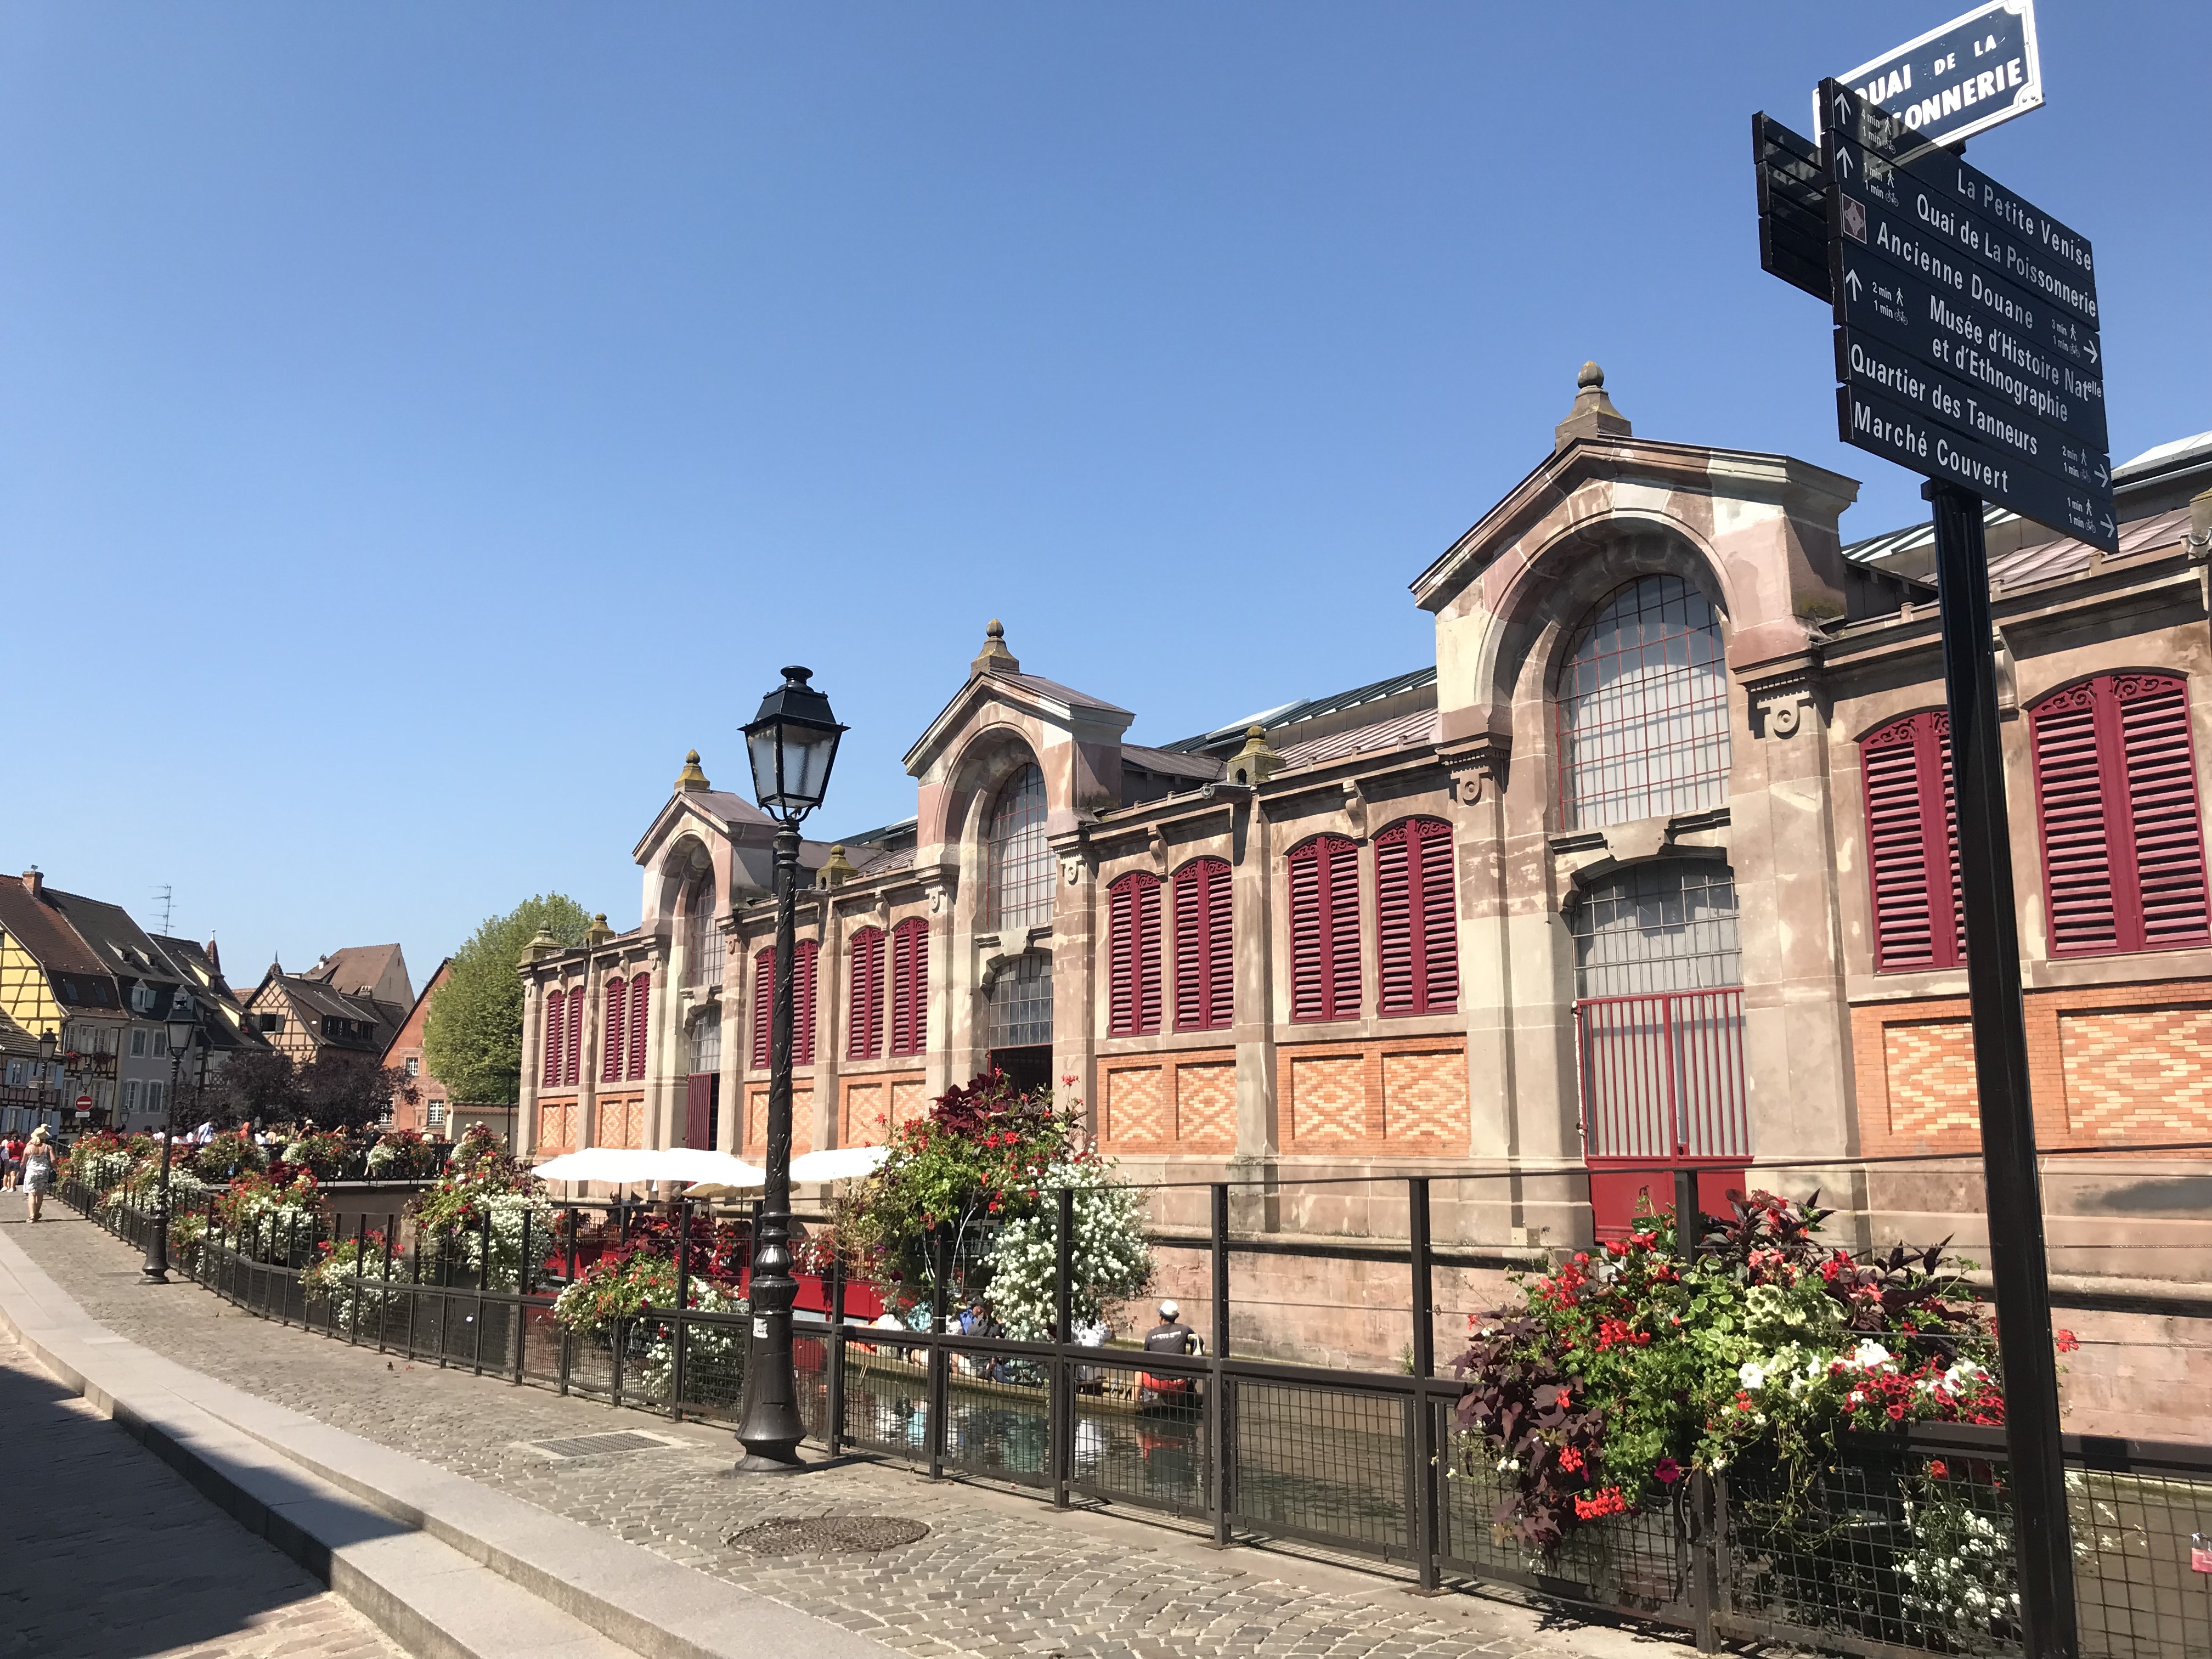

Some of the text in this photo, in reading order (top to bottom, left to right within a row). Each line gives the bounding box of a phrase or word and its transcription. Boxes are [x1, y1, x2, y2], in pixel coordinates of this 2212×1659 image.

[1934, 52, 1956, 76] DE
[1974, 34, 1997, 57] LA
[1892, 57, 2022, 130] ONNERIE
[1861, 108, 1881, 129] 4 min
[1862, 126, 1882, 146] 1 min
[1863, 162, 1883, 182] 1 min
[1864, 179, 1884, 199] 1 min
[1957, 168, 2091, 270] La Petite Venise
[1917, 194, 2096, 317] Quai de La Poissonnerie
[1877, 222, 2033, 329] Ancienne Douane
[1872, 281, 1892, 301] 2 min
[1874, 300, 1893, 319] 1 min
[2051, 319, 2067, 336] 3 min
[1930, 295, 1982, 345] Musée
[1988, 329, 2059, 385] d'Histoire
[2053, 335, 2068, 352] 1 min
[1933, 337, 2068, 422] et d'Ethnographie
[1851, 344, 2038, 455] Quartier des Tanneurs
[1854, 401, 2008, 493] Marché Couvert
[2062, 445, 2078, 462] 2 min
[2063, 462, 2079, 478] 1 min
[2067, 496, 2083, 512] 1 min
[2068, 513, 2085, 529] 1 min
